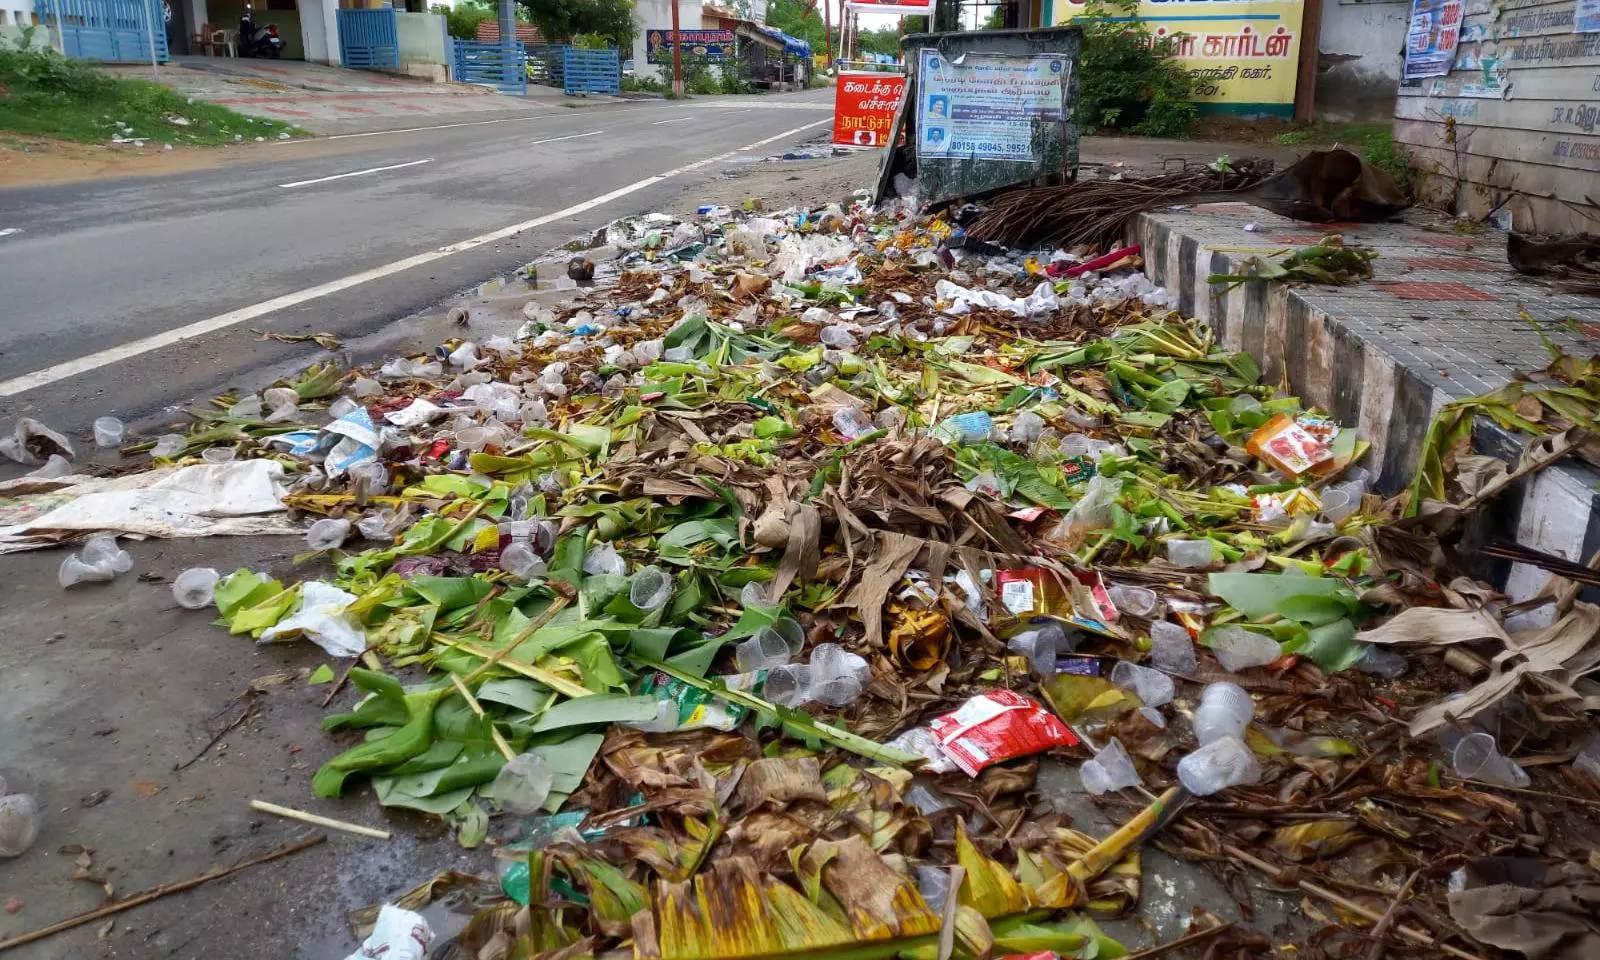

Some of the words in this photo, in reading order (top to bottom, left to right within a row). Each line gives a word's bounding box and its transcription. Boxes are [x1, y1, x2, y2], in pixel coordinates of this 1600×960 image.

[1203, 27, 1292, 57] கார்டன்
[844, 80, 891, 96] கடைக்கு
[859, 95, 900, 111] வச்சாச்
[842, 112, 891, 131] நாட்டுசர்
